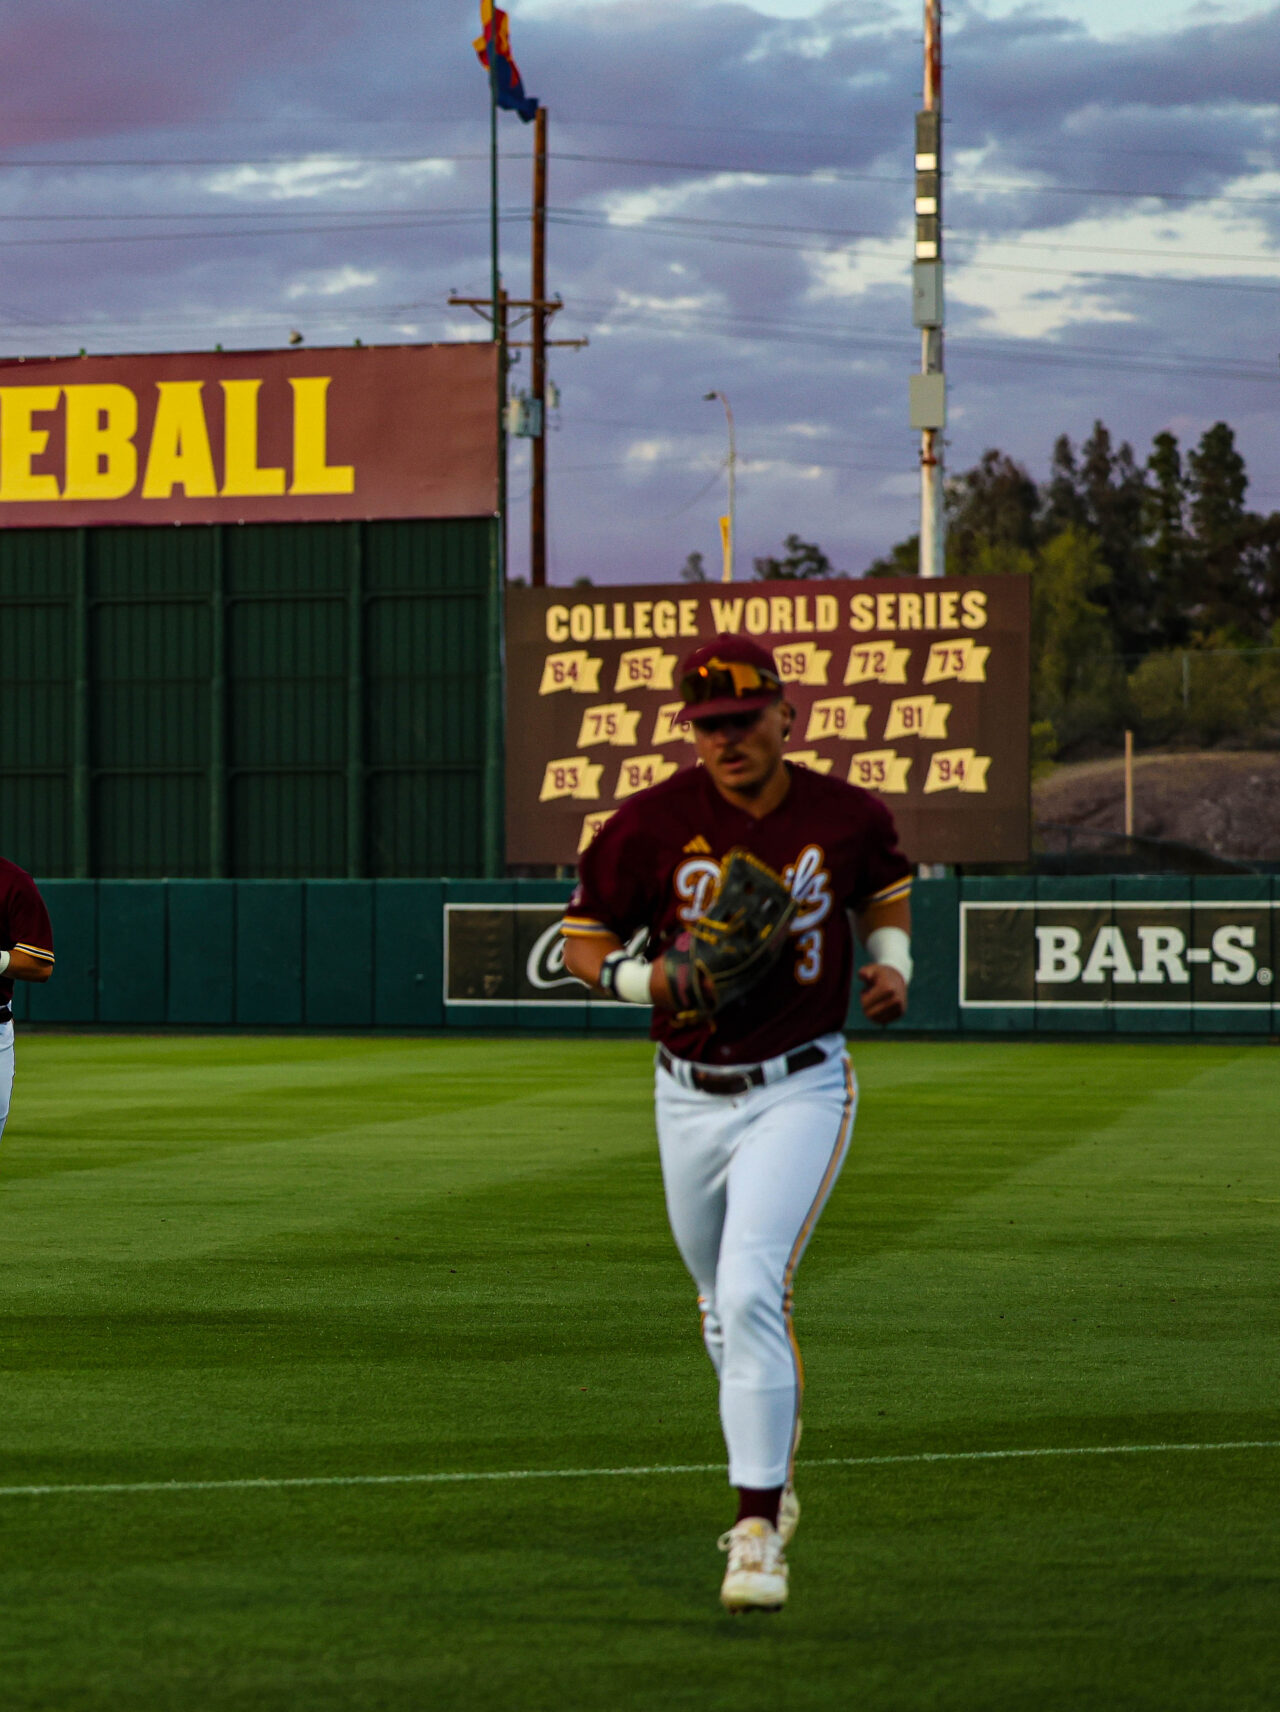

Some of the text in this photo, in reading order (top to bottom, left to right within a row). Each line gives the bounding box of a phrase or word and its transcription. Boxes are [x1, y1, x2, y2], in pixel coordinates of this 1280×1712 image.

[546, 590, 988, 643] COLLEGE WORLD SERIES
[797, 929, 821, 980] 3
